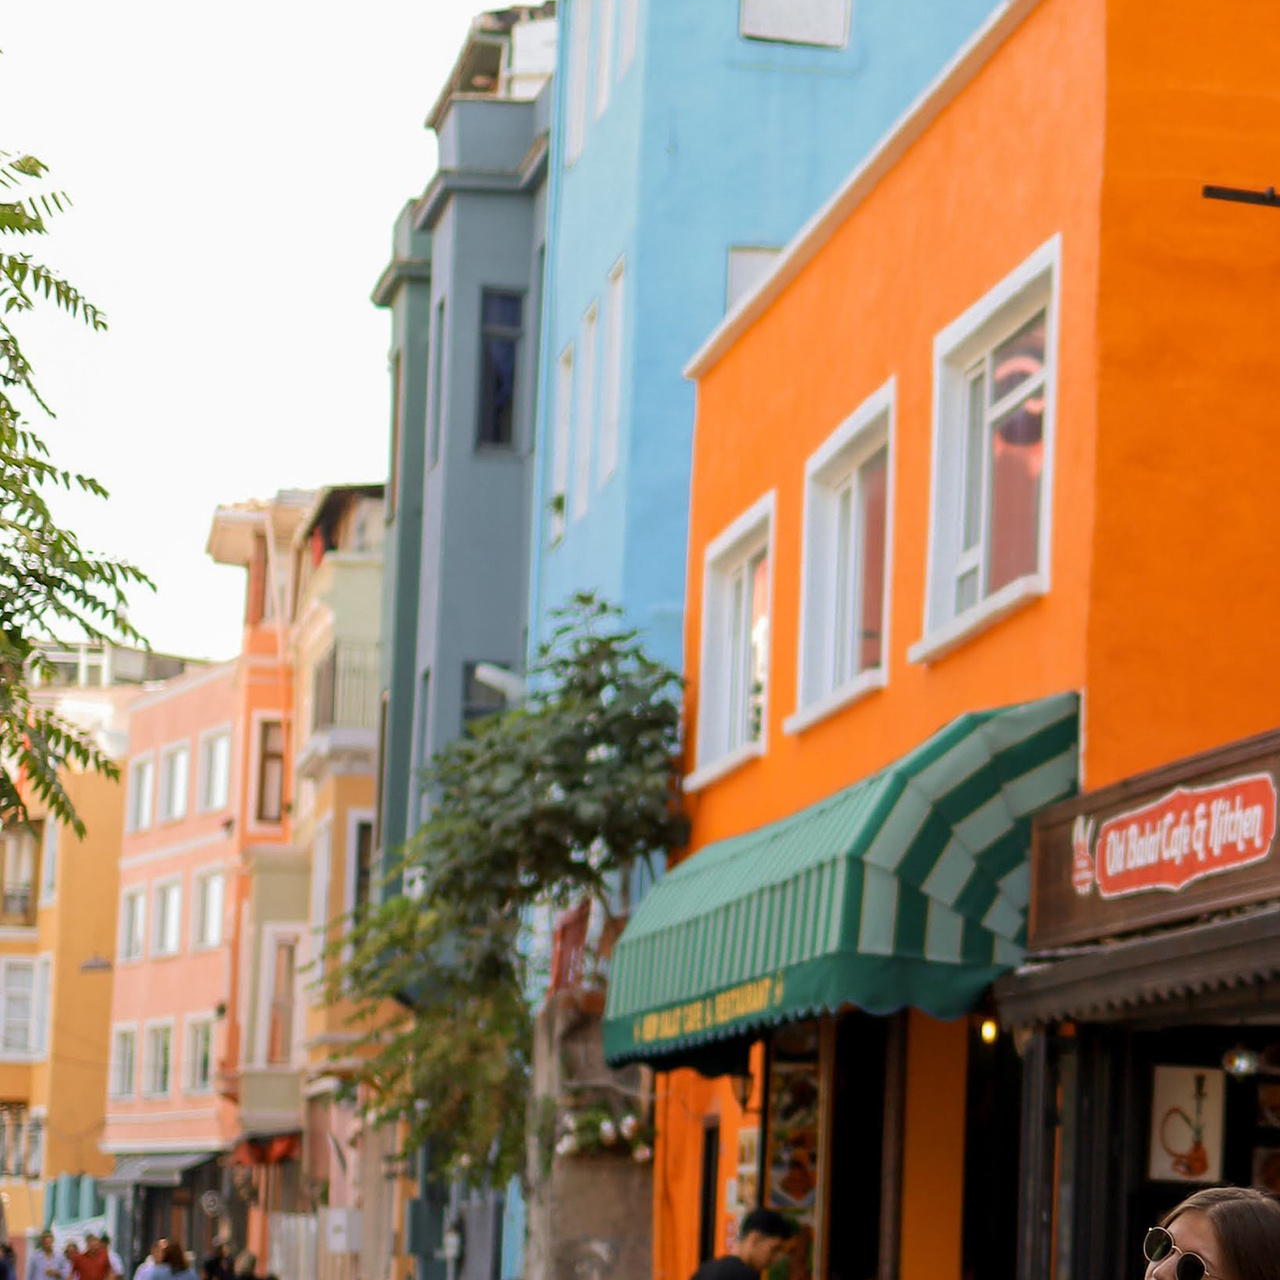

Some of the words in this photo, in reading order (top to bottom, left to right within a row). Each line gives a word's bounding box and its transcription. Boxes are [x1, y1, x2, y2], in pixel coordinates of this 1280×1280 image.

[1106, 830, 1126, 876] Old
[1162, 812, 1191, 865] Cafe
[1193, 802, 1207, 861] &
[1209, 796, 1263, 856] Kitchen
